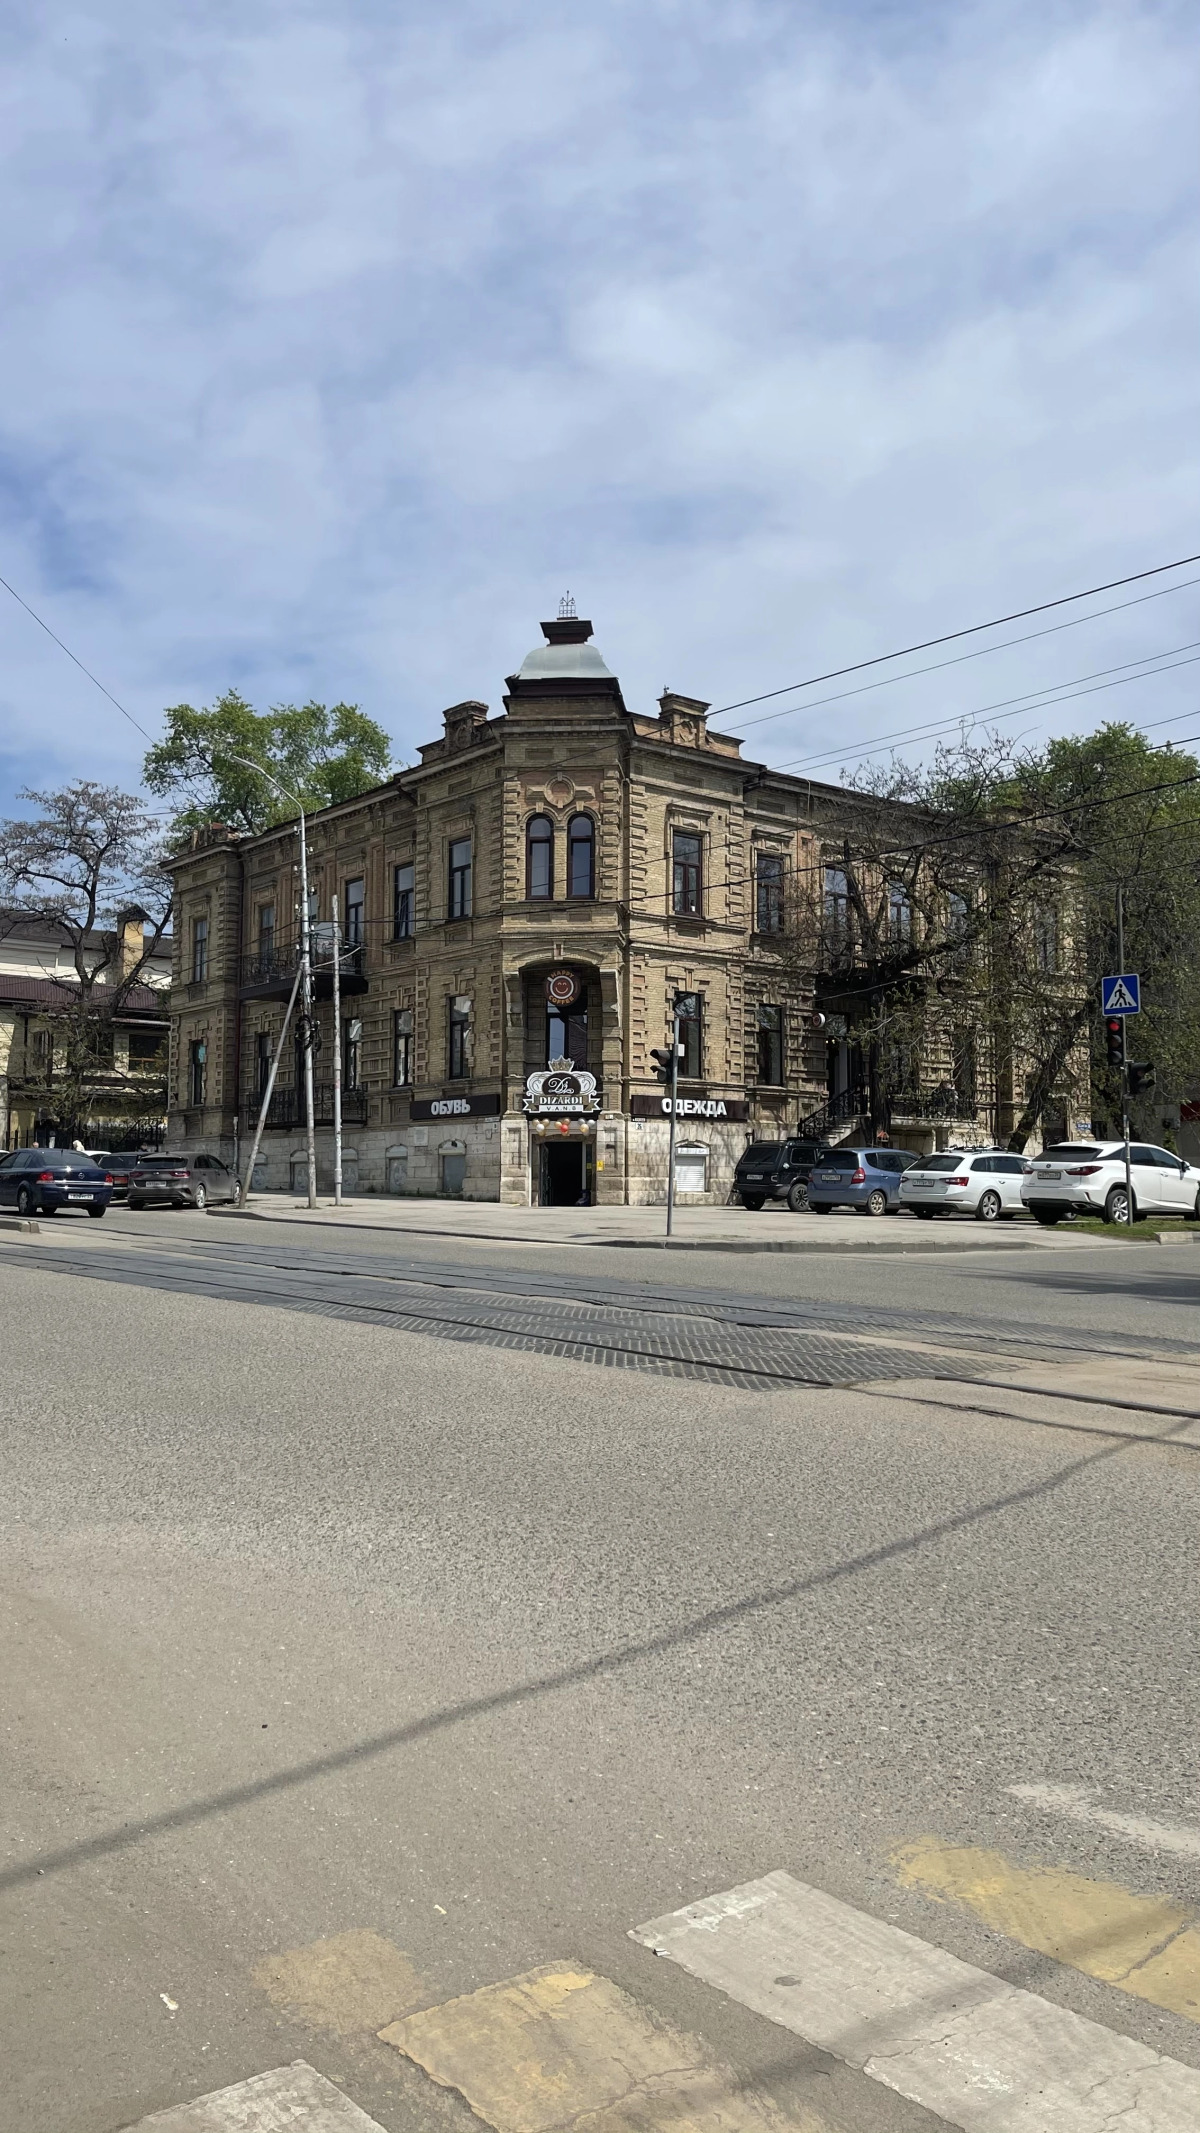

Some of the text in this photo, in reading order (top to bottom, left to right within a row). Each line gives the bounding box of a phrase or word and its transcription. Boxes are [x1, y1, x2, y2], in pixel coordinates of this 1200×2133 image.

[550, 970, 575, 978] HAPPY
[548, 995, 575, 1005] COFFEE
[540, 1096, 582, 1105] DIZARDI
[430, 1098, 471, 1116] ОБУВЬ
[661, 1098, 727, 1117] ОДЕЖДА
